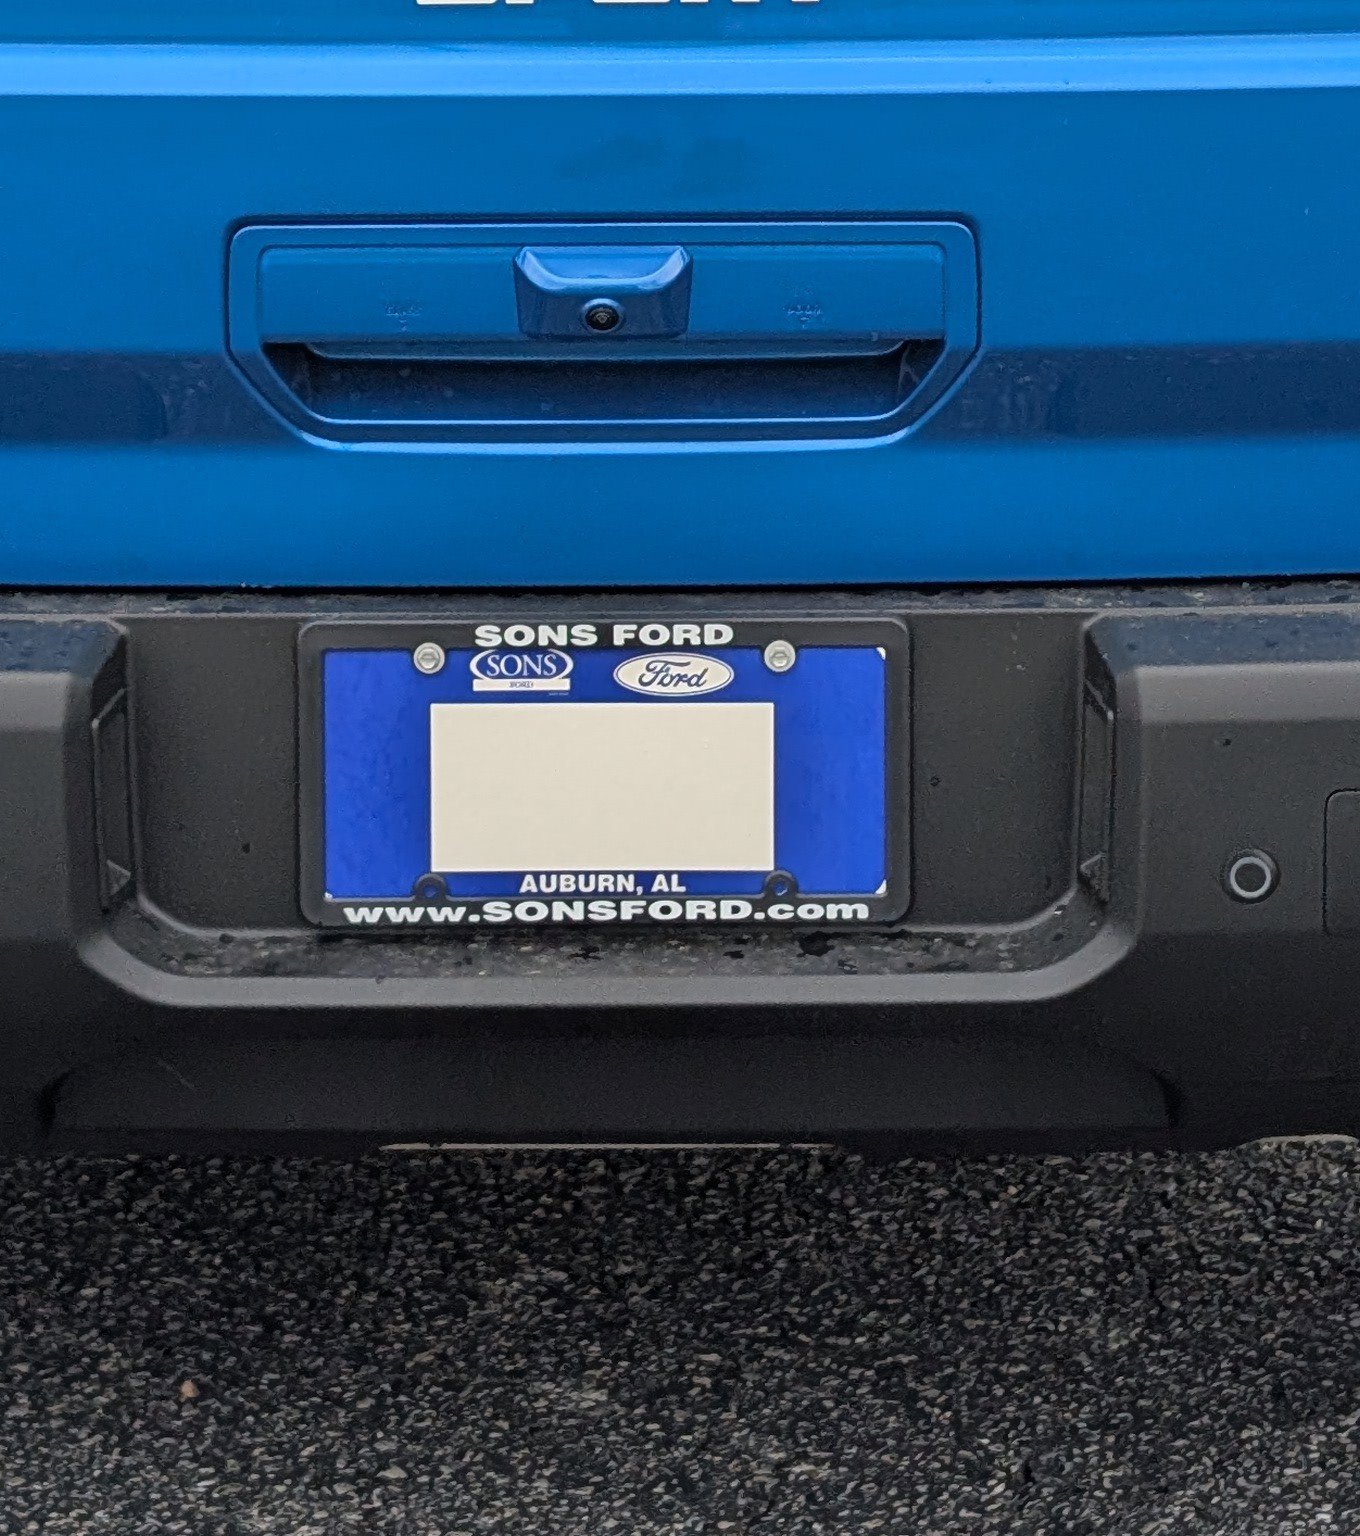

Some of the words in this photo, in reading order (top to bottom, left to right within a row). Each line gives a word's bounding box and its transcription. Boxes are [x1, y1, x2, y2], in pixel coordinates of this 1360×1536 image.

[474, 624, 598, 647] SONS
[612, 624, 735, 647] FORD
[486, 653, 558, 678] SONS
[638, 659, 709, 688] Ford
[519, 873, 643, 896] AUBURN,
[650, 873, 687, 893] AL
[343, 900, 870, 923] www.SONSFORD.com
